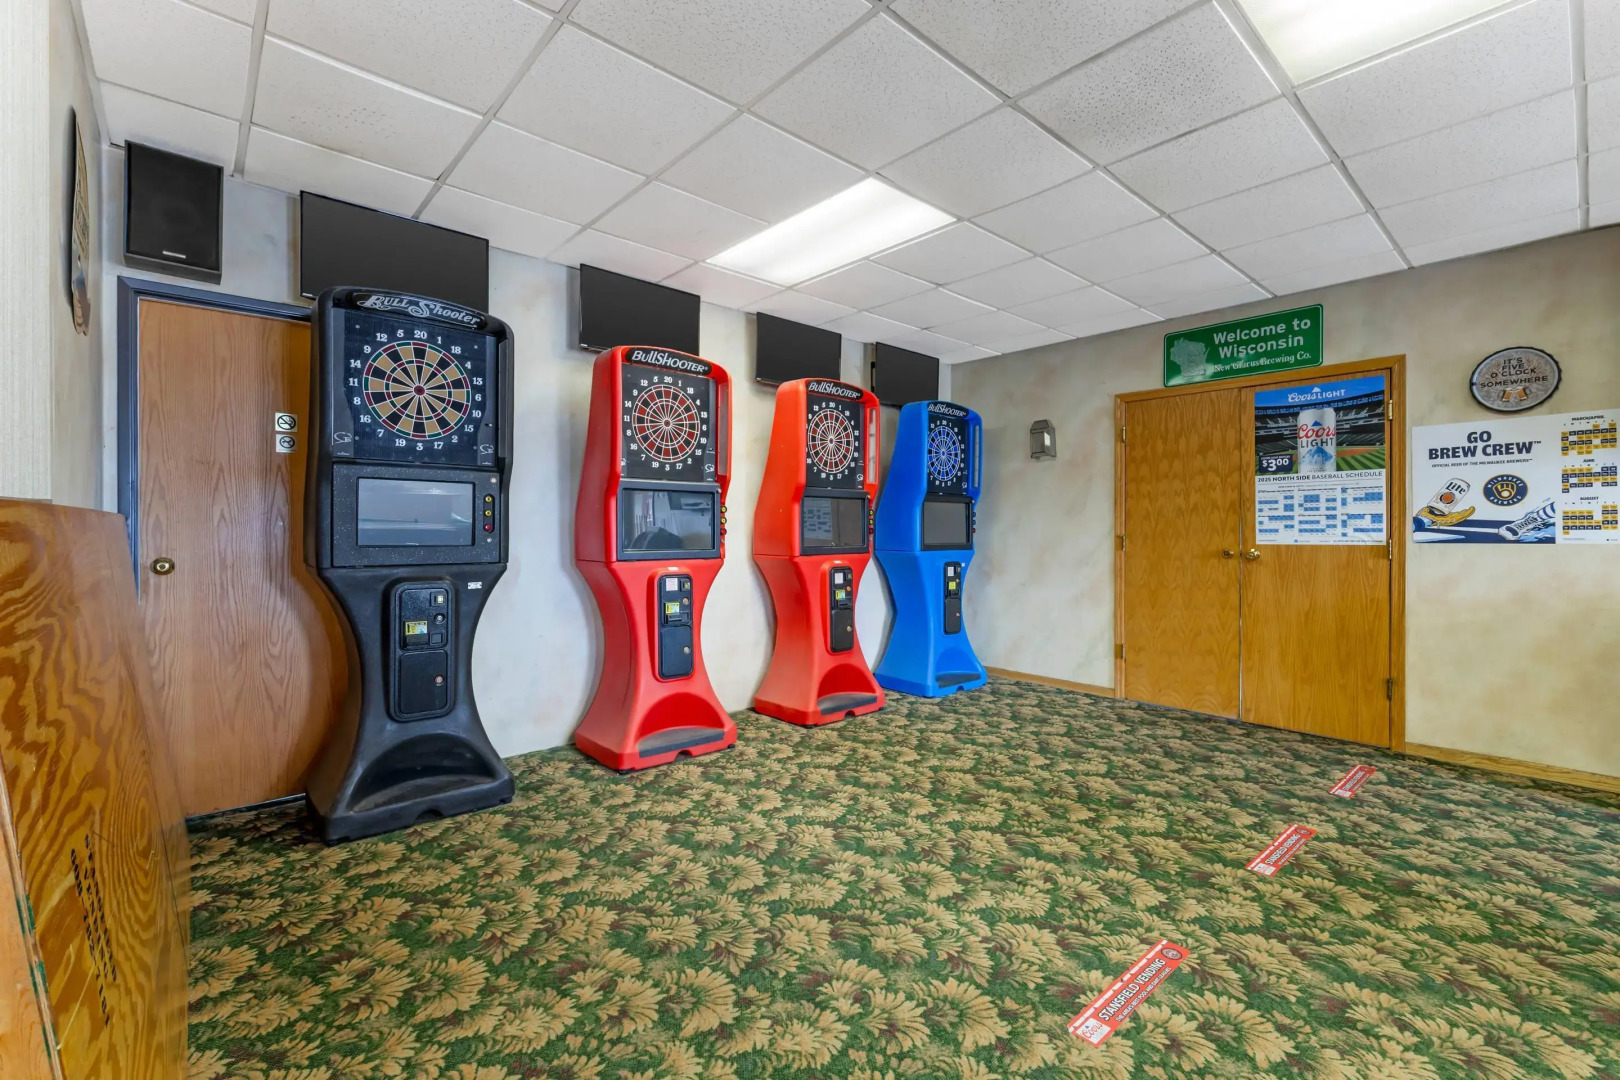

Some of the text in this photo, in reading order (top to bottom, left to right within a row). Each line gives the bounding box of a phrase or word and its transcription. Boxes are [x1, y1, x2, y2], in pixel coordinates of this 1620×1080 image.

[376, 333, 387, 341] 12
[414, 330, 427, 339] 20
[1213, 318, 1310, 344] Welcome to
[1219, 335, 1304, 358] Wisconsin
[350, 360, 361, 368] 14
[1259, 354, 1294, 365] Brewing
[1297, 351, 1311, 360] Co.
[1502, 363, 1525, 371] FIVE
[1480, 376, 1548, 388] SOMEWHERE
[1288, 389, 1345, 402] Coors LIGHT
[1298, 424, 1336, 439] Coors
[1467, 430, 1492, 444] GO
[1301, 438, 1334, 448] LIGHT
[1428, 445, 1478, 460] BREW
[1445, 481, 1466, 495] Lite
[1487, 476, 1524, 488] MILWAUKEE
[1098, 958, 1166, 1021] STANSFIELD VENDING
[1082, 1022, 1103, 1039] Coors
